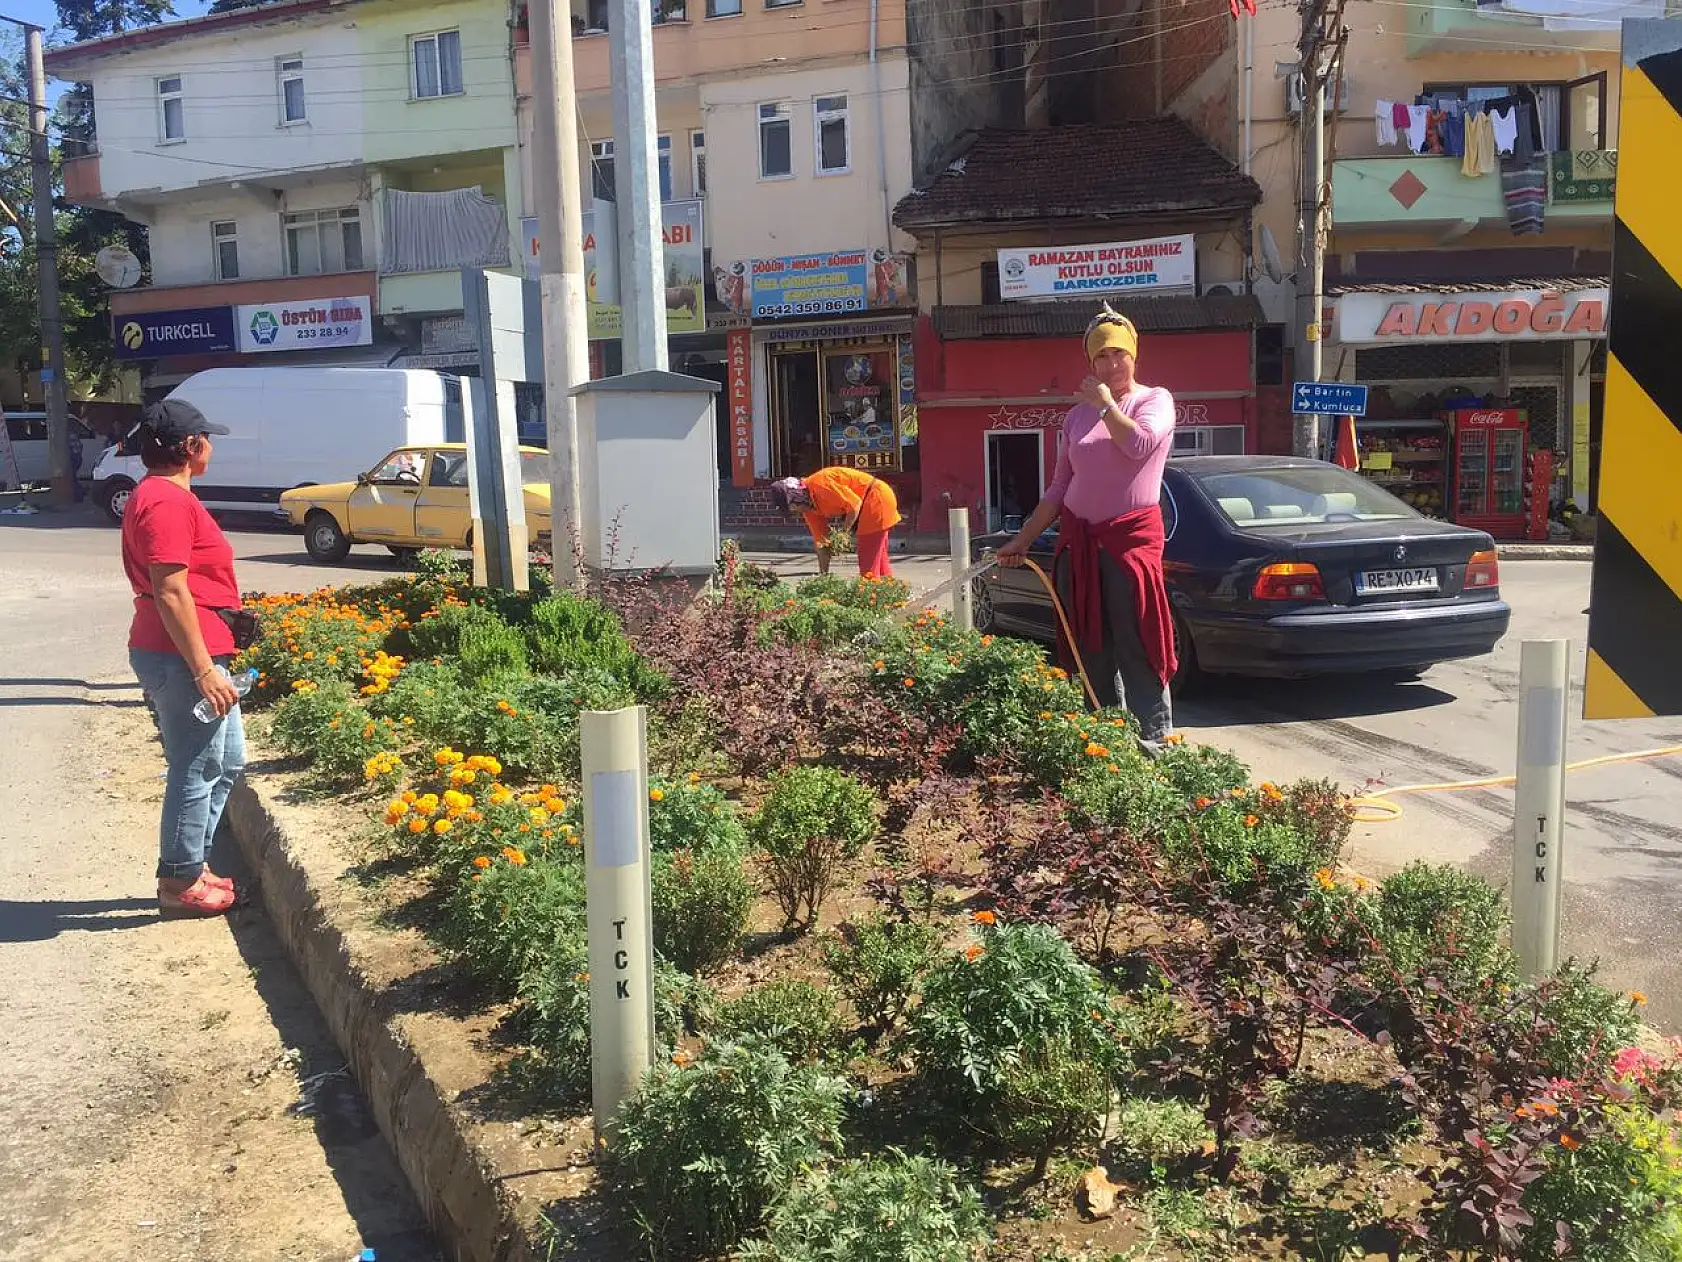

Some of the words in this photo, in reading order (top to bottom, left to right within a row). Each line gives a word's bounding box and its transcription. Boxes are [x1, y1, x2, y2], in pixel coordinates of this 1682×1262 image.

[1028, 250, 1094, 266] RAMAZAN
[1098, 242, 1182, 260] BAYRAMINIZ
[1059, 265, 1102, 279] KUTLU
[1108, 260, 1153, 274] OLSUN
[282, 307, 326, 326] ÜSTÜN
[758, 303, 791, 316] 0542
[795, 301, 820, 314] 359
[825, 300, 843, 312] 86
[847, 299, 863, 310] 91
[1375, 292, 1608, 335] AKDOĞA
[147, 322, 216, 342] TURKCELL
[297, 329, 317, 339] 233
[732, 336, 745, 398] KARTAL
[1314, 402, 1362, 412] Kumluca
[1016, 408, 1067, 428] Sta
[1368, 571, 1387, 588] RE
[1535, 817, 1547, 883] TCK
[612, 920, 630, 999] TCK
